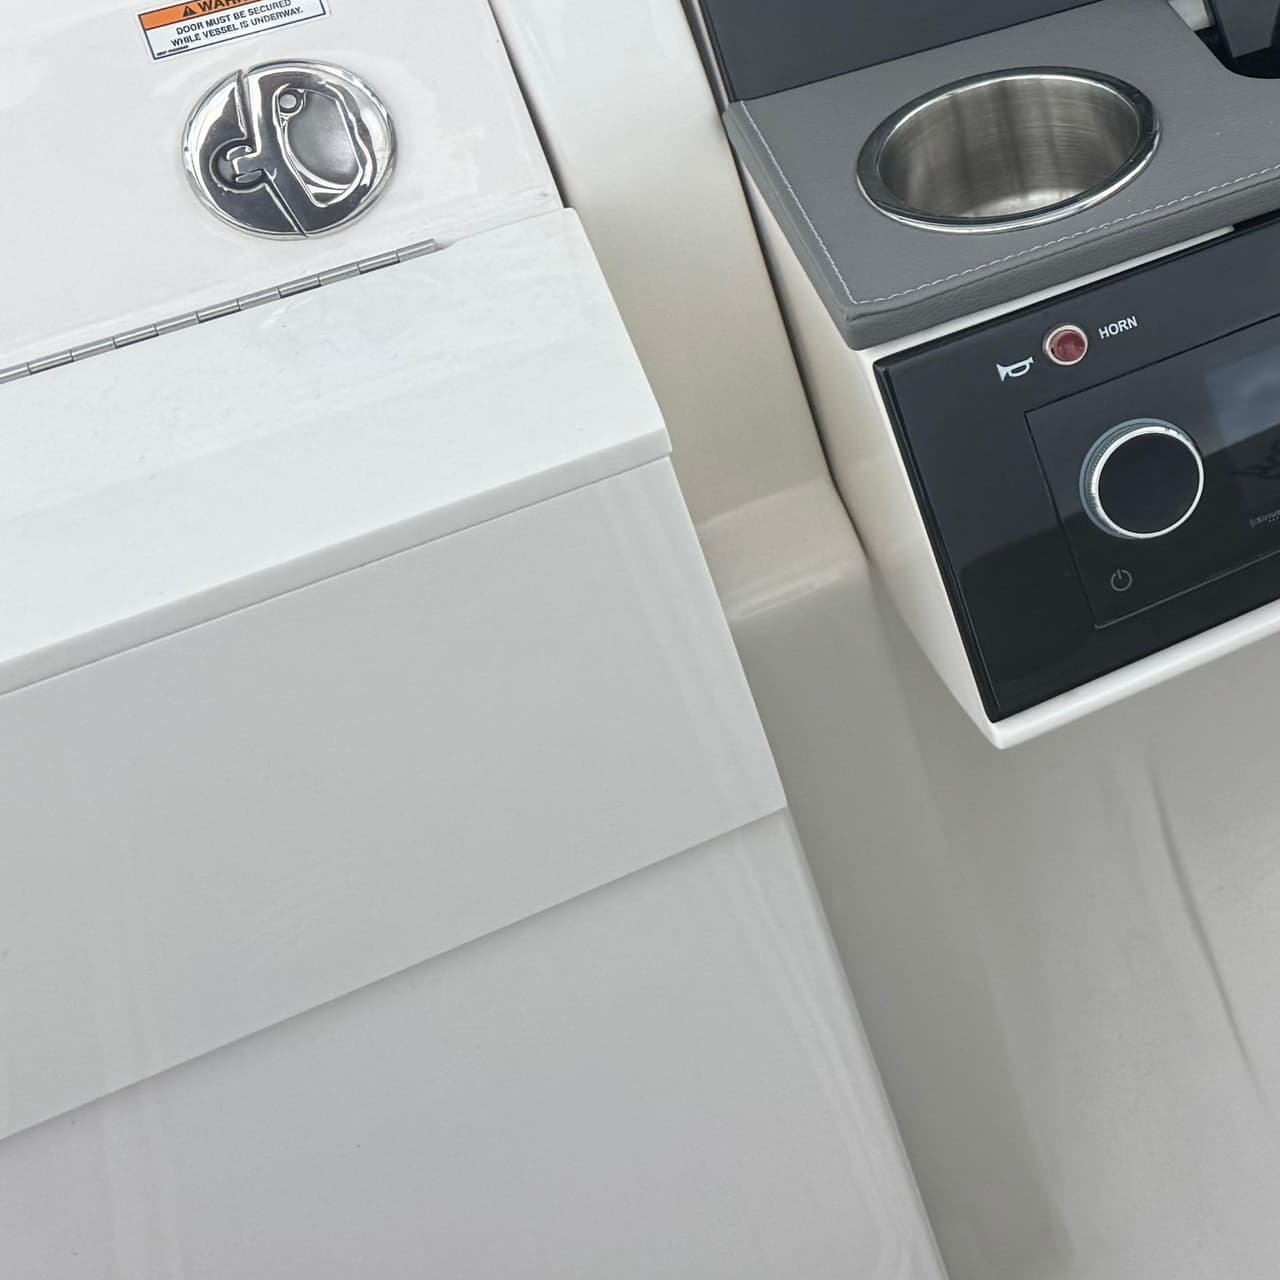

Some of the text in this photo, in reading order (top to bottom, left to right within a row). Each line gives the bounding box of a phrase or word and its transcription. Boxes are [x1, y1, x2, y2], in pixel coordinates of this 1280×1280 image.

[170, 5, 304, 48] WHILE VESSEL IS UNDERWAY.
[175, 20, 204, 36] DOOR
[205, 14, 231, 29] MUST
[233, 10, 247, 22] BE
[1098, 315, 1138, 339] HORN
